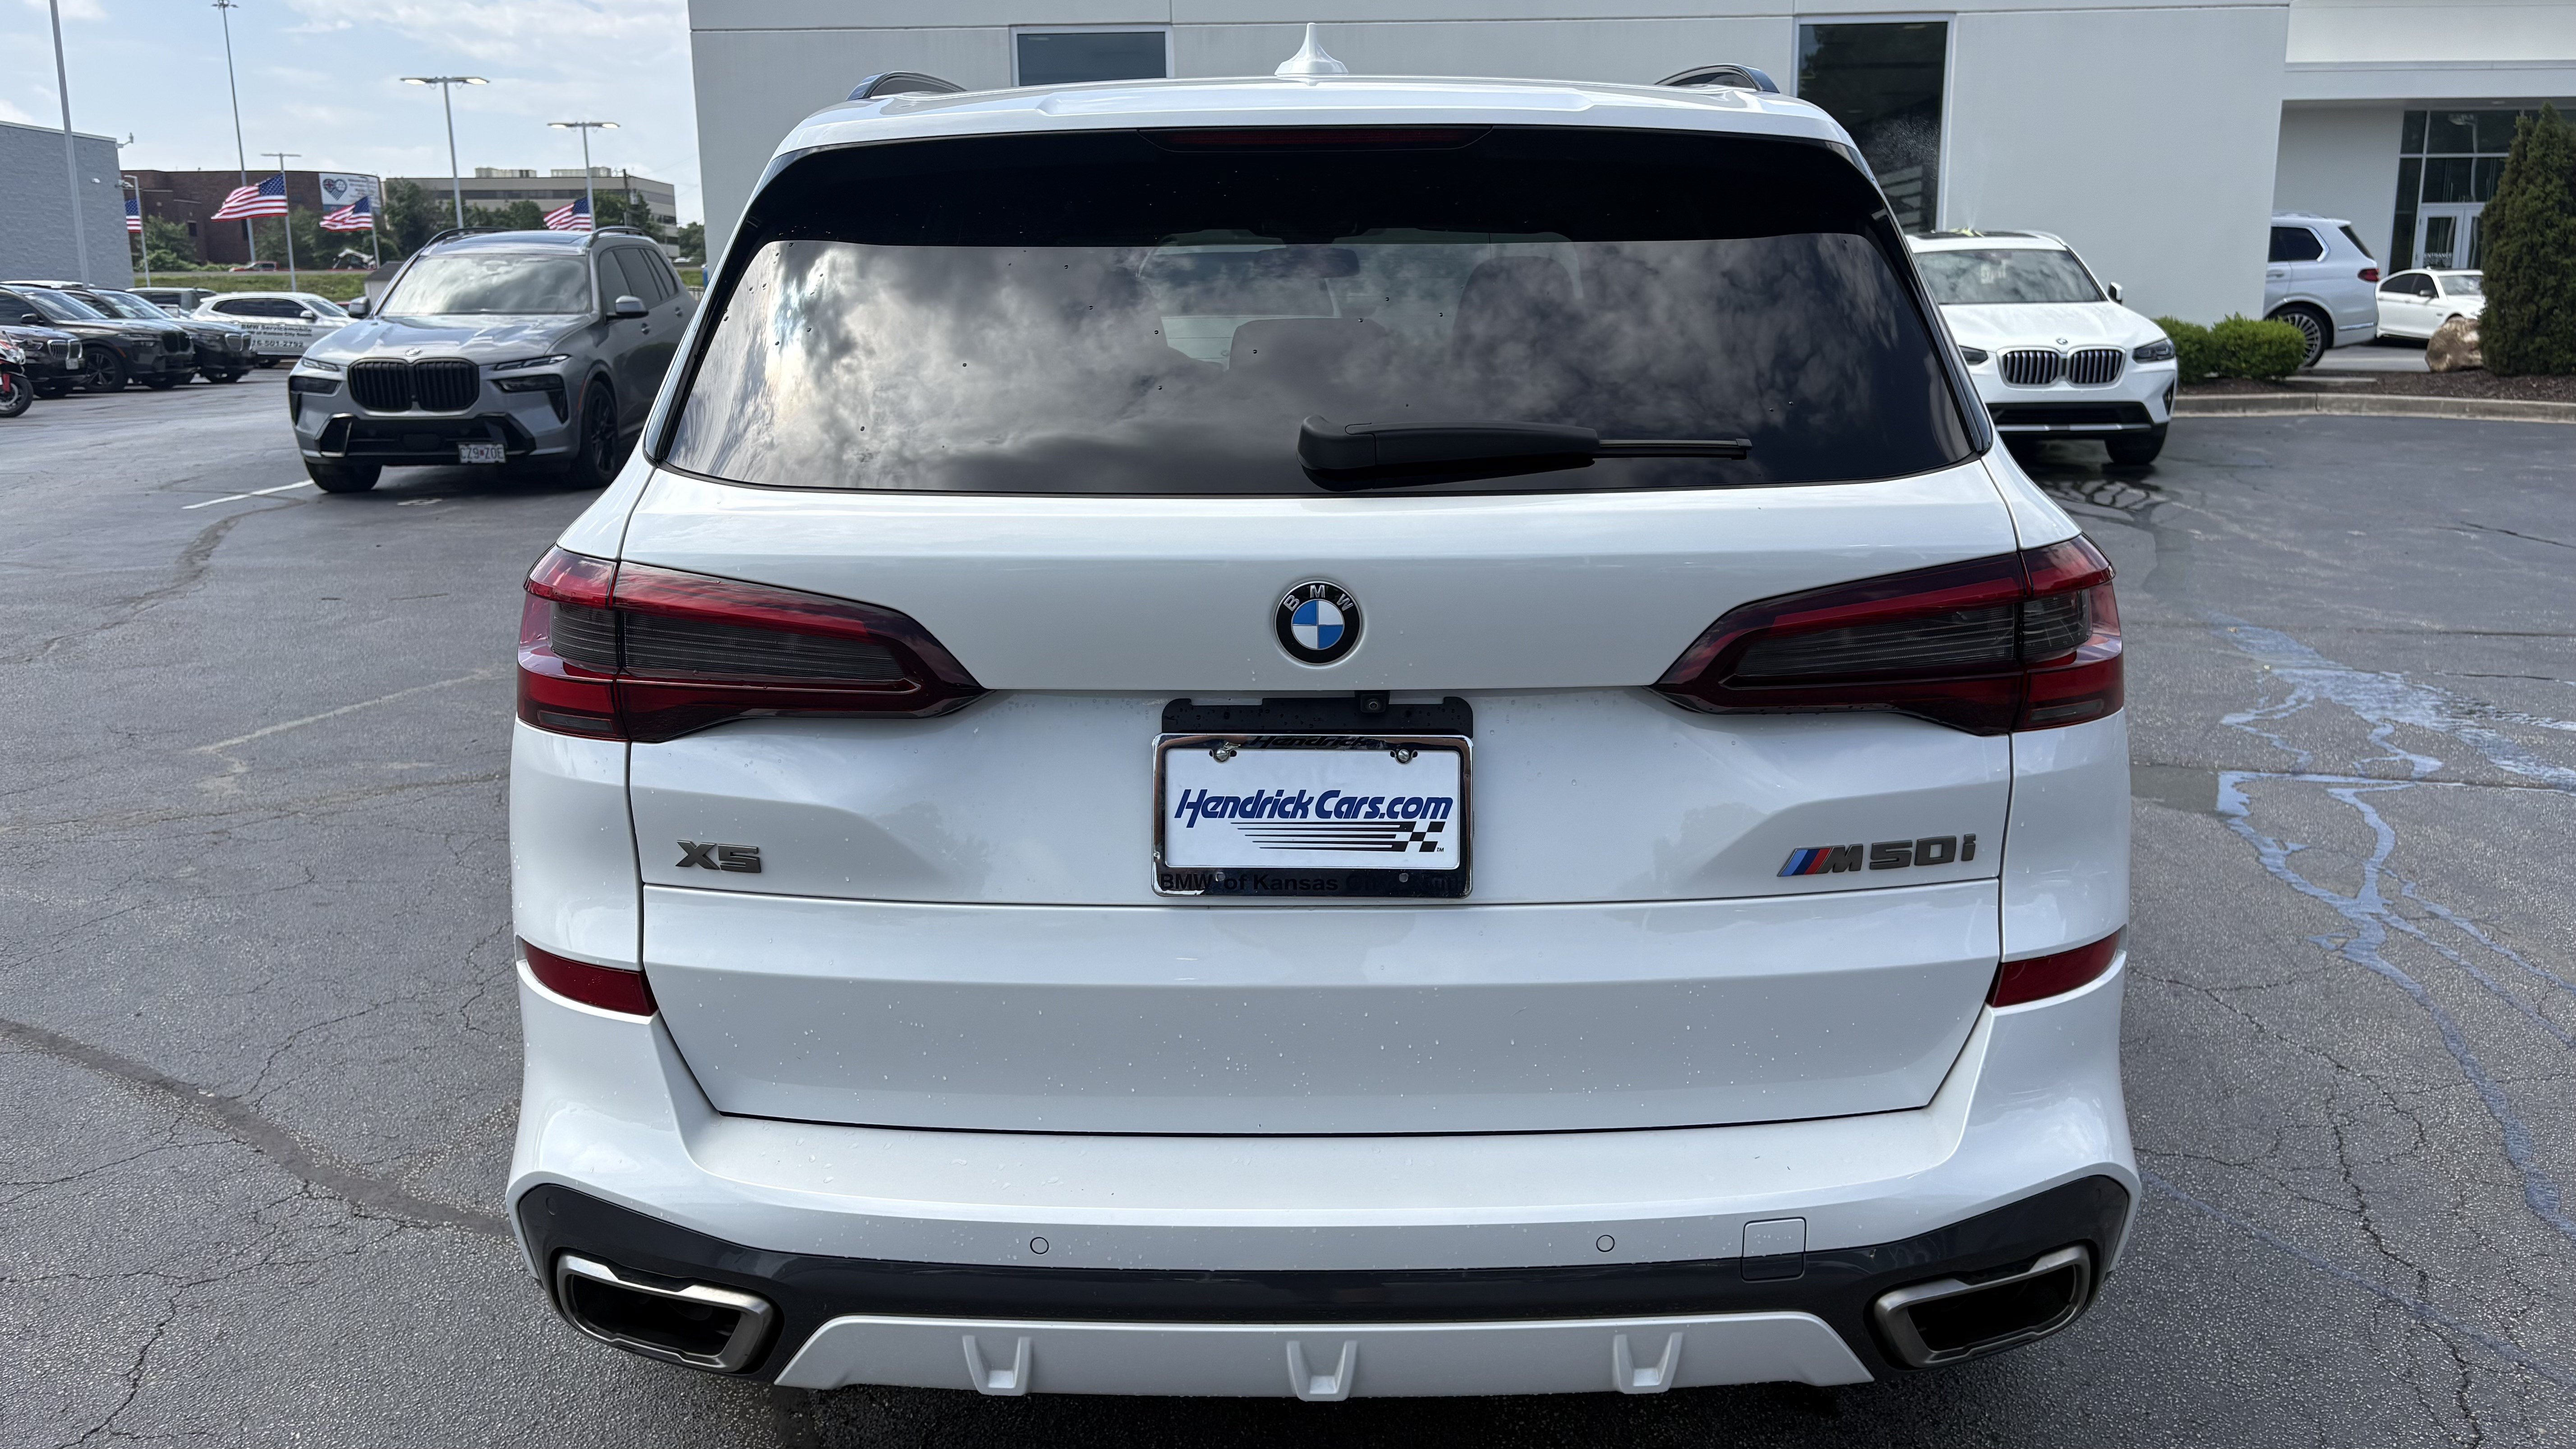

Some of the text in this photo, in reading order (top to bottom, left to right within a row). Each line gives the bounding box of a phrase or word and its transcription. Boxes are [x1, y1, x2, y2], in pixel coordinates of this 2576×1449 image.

[1283, 584, 1354, 612] BMW
[675, 840, 761, 873] X5
[1160, 873, 1213, 890] BMW
[1224, 874, 1247, 890] of
[1253, 874, 1339, 891] Kansas
